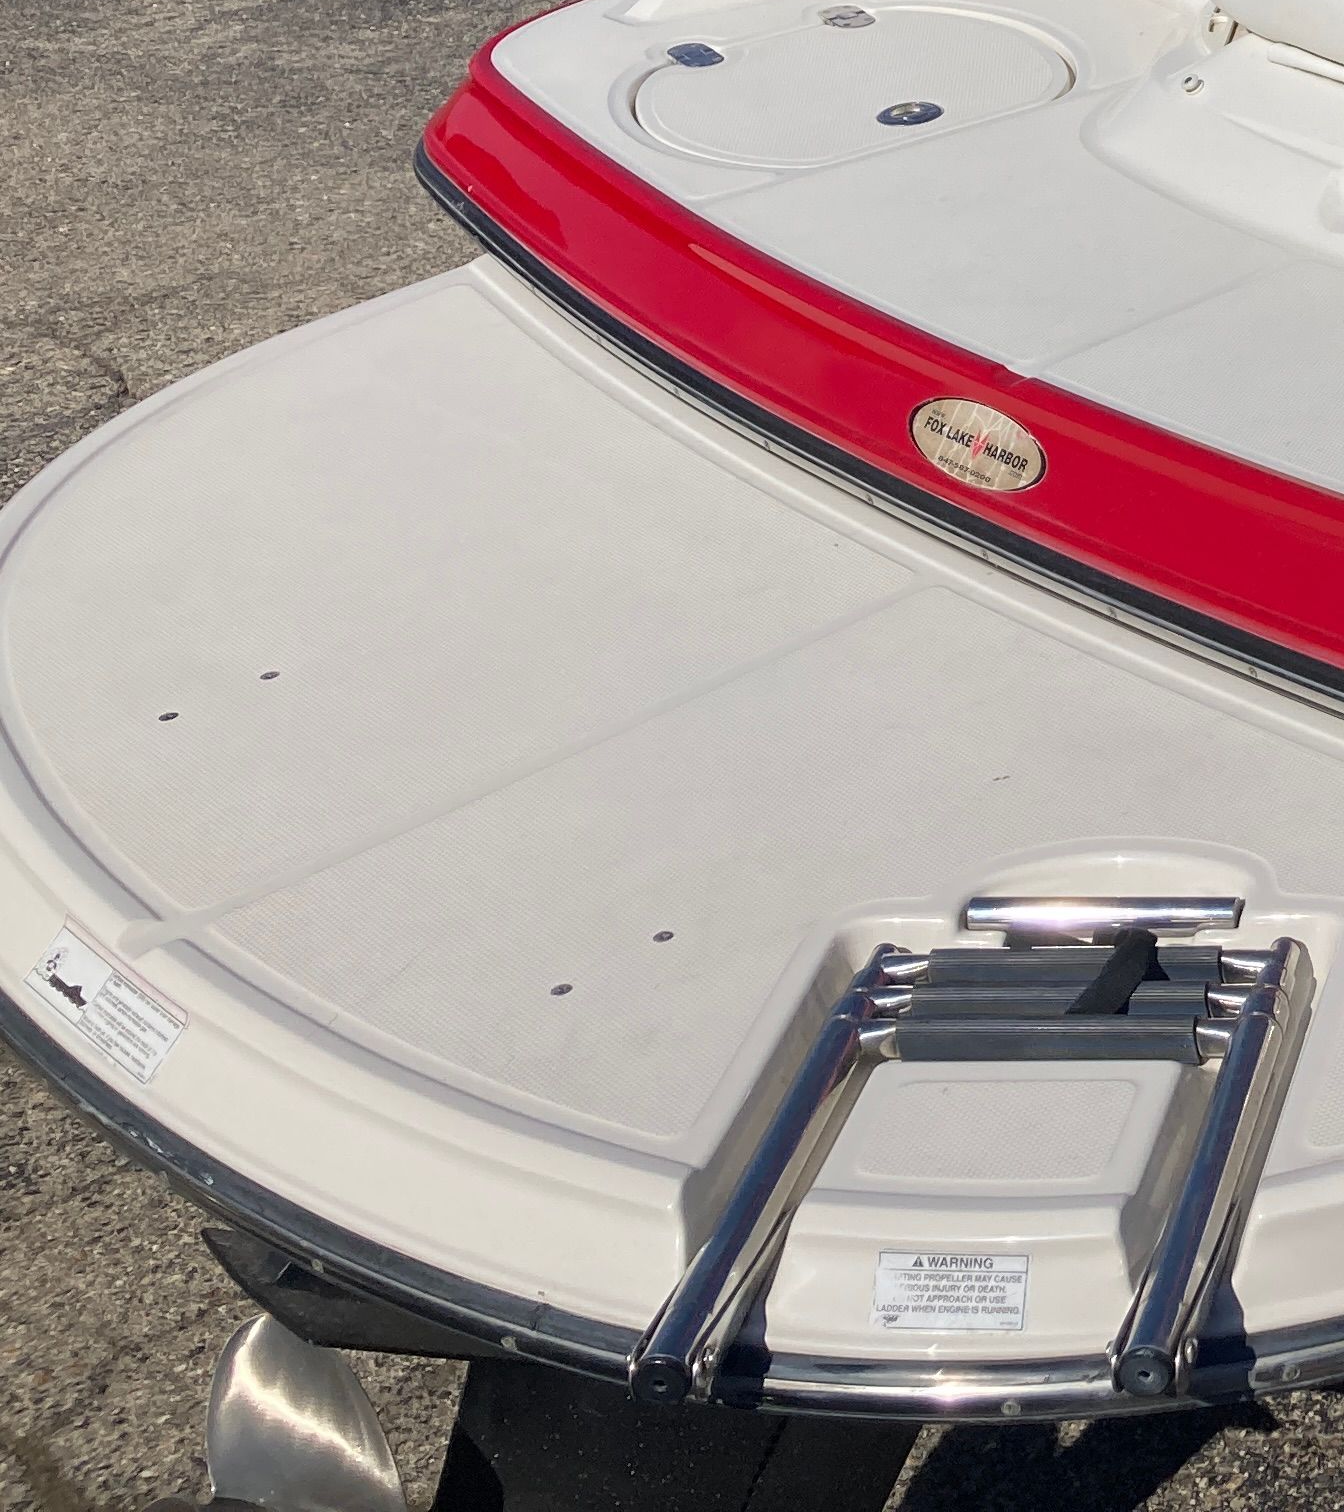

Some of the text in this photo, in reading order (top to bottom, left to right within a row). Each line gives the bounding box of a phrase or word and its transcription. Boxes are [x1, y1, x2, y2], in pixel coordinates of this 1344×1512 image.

[923, 416, 1029, 472] FOX LAKE HARBOR
[927, 1256, 994, 1270] WARNING
[924, 1273, 973, 1283] PROPELLER
[975, 1274, 992, 1283] MAY
[994, 1275, 1022, 1284] CAUSE
[932, 1284, 961, 1294] INJURY
[962, 1285, 976, 1294] OR
[926, 1294, 973, 1304] APPROACH
[975, 1295, 987, 1304] OR
[989, 1295, 1007, 1304] USE
[876, 1304, 909, 1313] LADDER
[911, 1304, 936, 1313] WHEN
[938, 1305, 970, 1314] ENGINE
